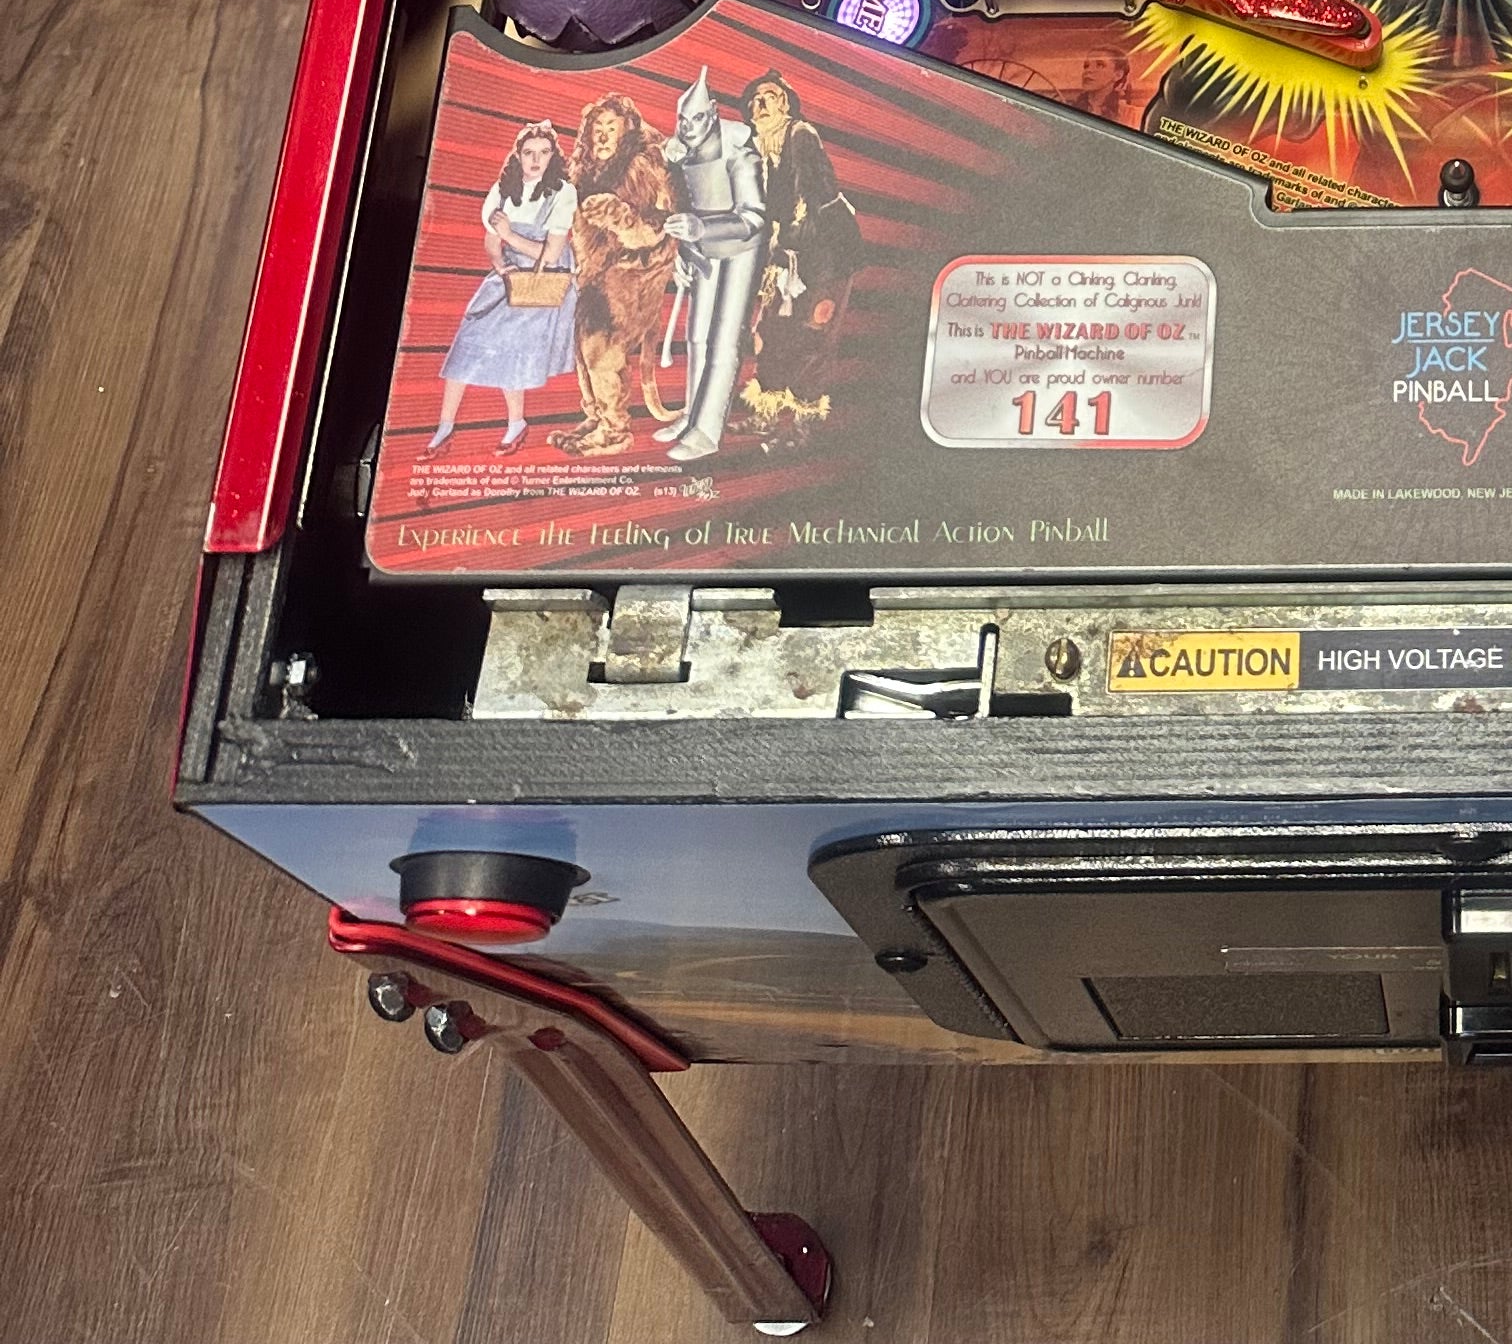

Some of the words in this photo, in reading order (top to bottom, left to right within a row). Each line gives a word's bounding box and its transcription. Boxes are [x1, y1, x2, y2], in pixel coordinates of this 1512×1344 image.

[1160, 118, 1183, 133] THE
[1185, 129, 1231, 152] WIZARD
[1233, 145, 1250, 157] OF
[1250, 151, 1269, 164] OZ
[1270, 158, 1290, 173] and
[1291, 167, 1306, 178] all
[1307, 172, 1346, 193] related
[1311, 189, 1325, 200] of
[1324, 194, 1346, 208] and
[976, 271, 995, 286] This
[1002, 273, 1010, 286] is
[1017, 271, 1045, 286] NOT
[946, 292, 1006, 311] Clattering
[1014, 292, 1077, 309] Collection
[1084, 293, 1101, 308] of
[1105, 292, 1167, 312] Caliginous
[948, 323, 973, 338] This
[974, 323, 985, 338] is
[990, 322, 1032, 340] THE
[1036, 322, 1120, 340] WIZARD
[1124, 322, 1152, 340] OF
[1392, 312, 1499, 344] JERSEY
[1014, 345, 1062, 360] Pinball
[1065, 345, 1125, 360] Machine
[1406, 346, 1488, 378] JACK
[951, 371, 976, 385] and
[984, 370, 1012, 385] YOU
[1019, 374, 1040, 385] are
[1047, 370, 1086, 388] proud
[1092, 374, 1130, 385] owner
[1137, 372, 1184, 385] number
[1393, 380, 1499, 402] PINBALL
[1012, 390, 1112, 436] 141
[412, 465, 431, 474] THE
[433, 465, 471, 474] WIZARD
[473, 465, 487, 474] OF
[522, 476, 550, 485] Turner
[568, 487, 607, 496] WIZARD
[1333, 489, 1371, 500] MADE
[1373, 489, 1385, 500] IN
[1467, 488, 1496, 499] NEW
[1149, 647, 1292, 677] CAUTION
[1317, 649, 1381, 672] HIGH
[1388, 646, 1502, 671] VOLTAGE
